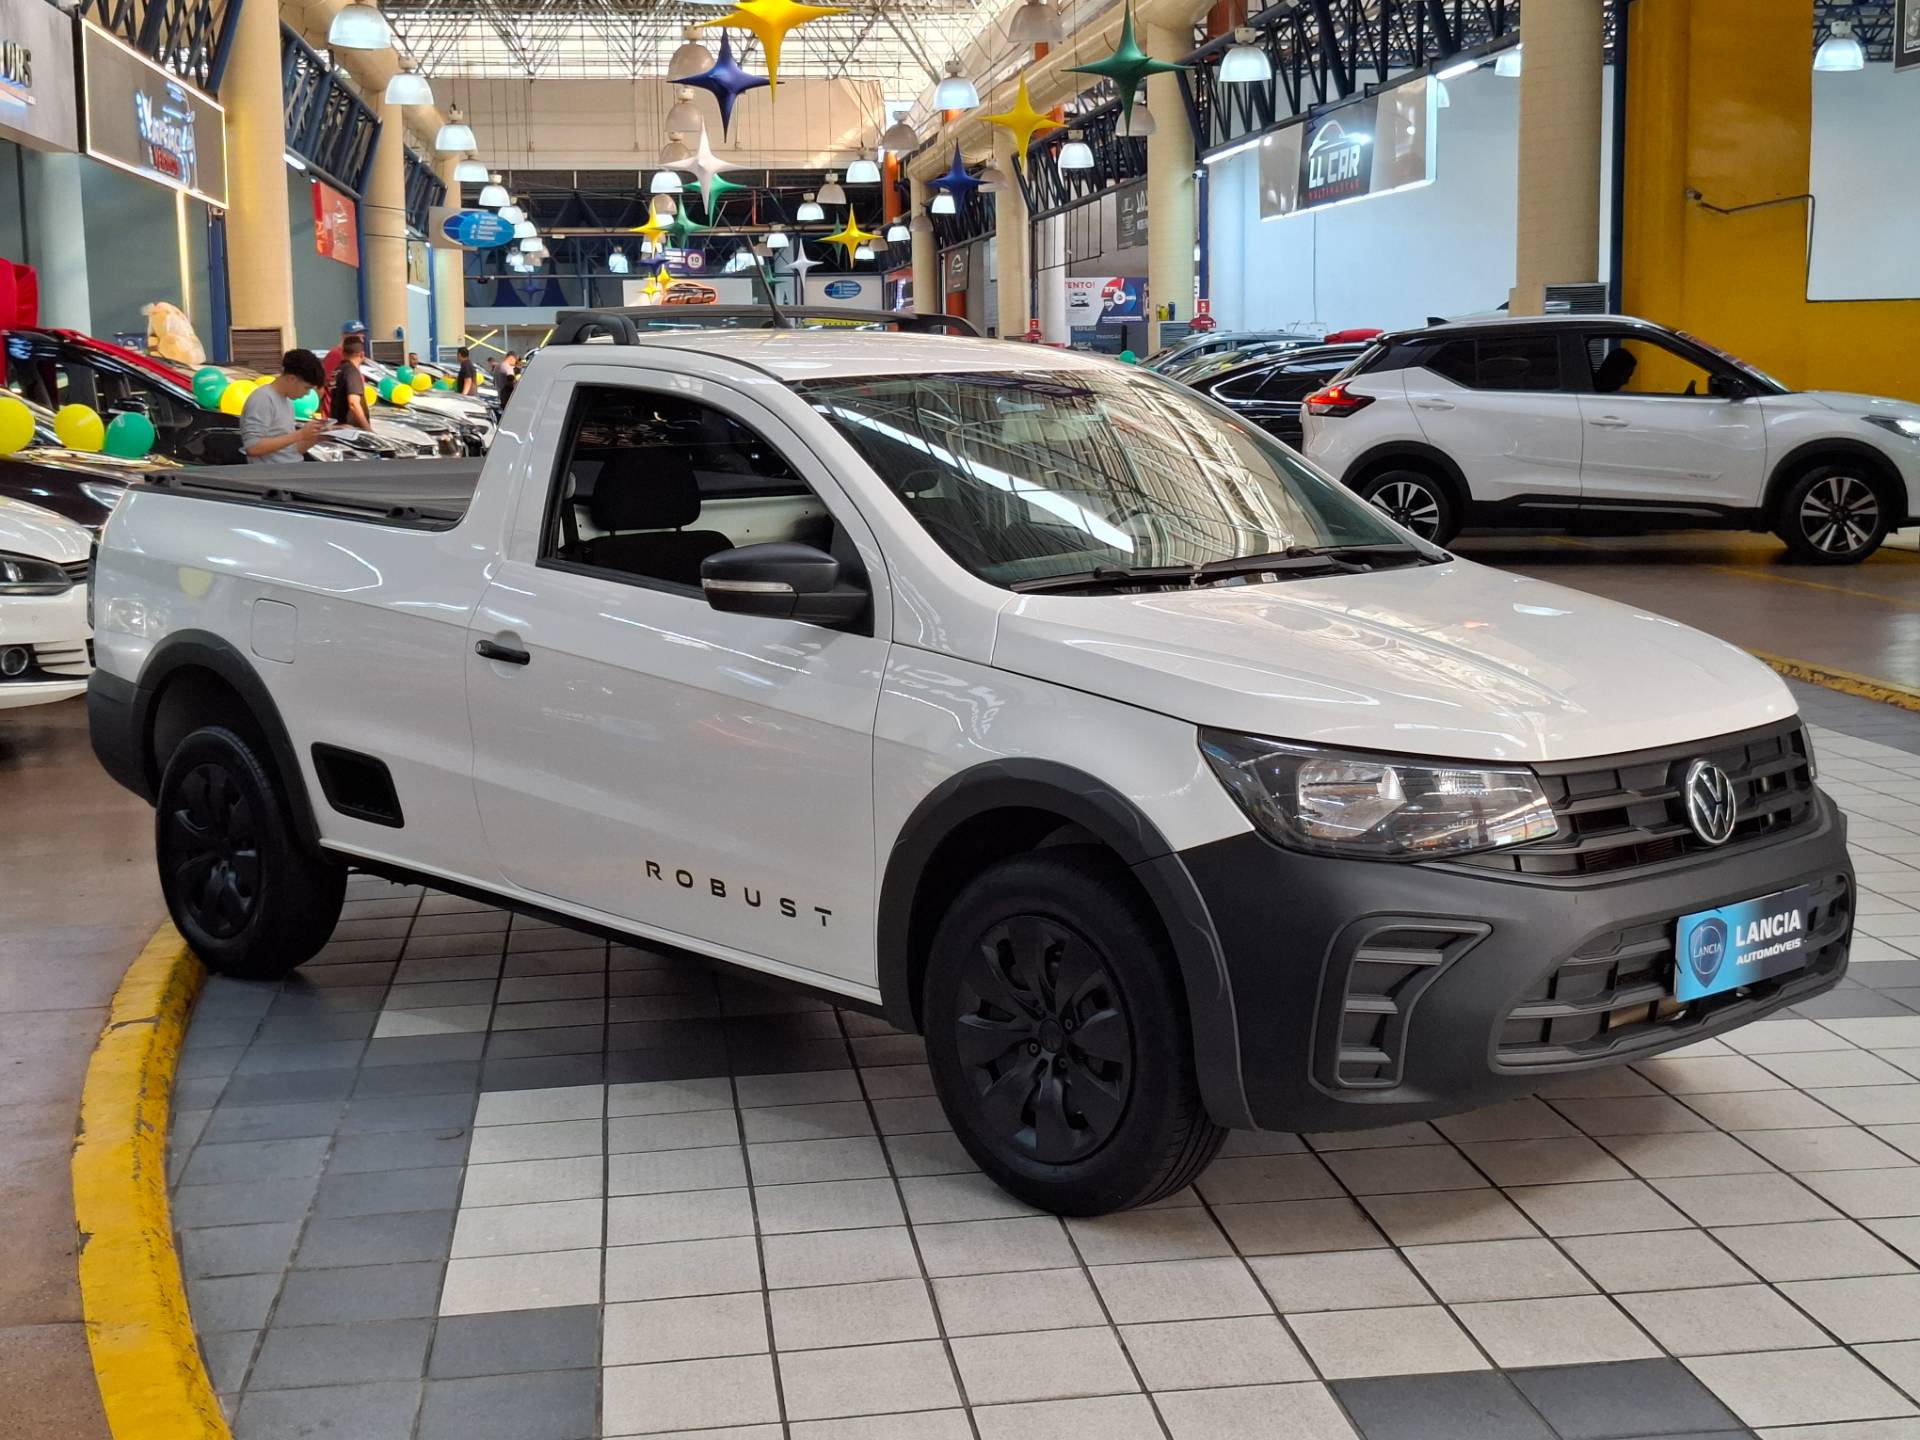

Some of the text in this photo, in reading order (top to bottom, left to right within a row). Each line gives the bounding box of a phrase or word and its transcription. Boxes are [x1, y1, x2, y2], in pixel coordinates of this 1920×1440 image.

[1309, 144, 1361, 189] LL CAR
[645, 860, 832, 927] ROBUST
[1736, 909, 1801, 947] LANCIA
[1693, 942, 1722, 958] LANCIA
[1736, 938, 1802, 965] AUTOMÓVEIS
